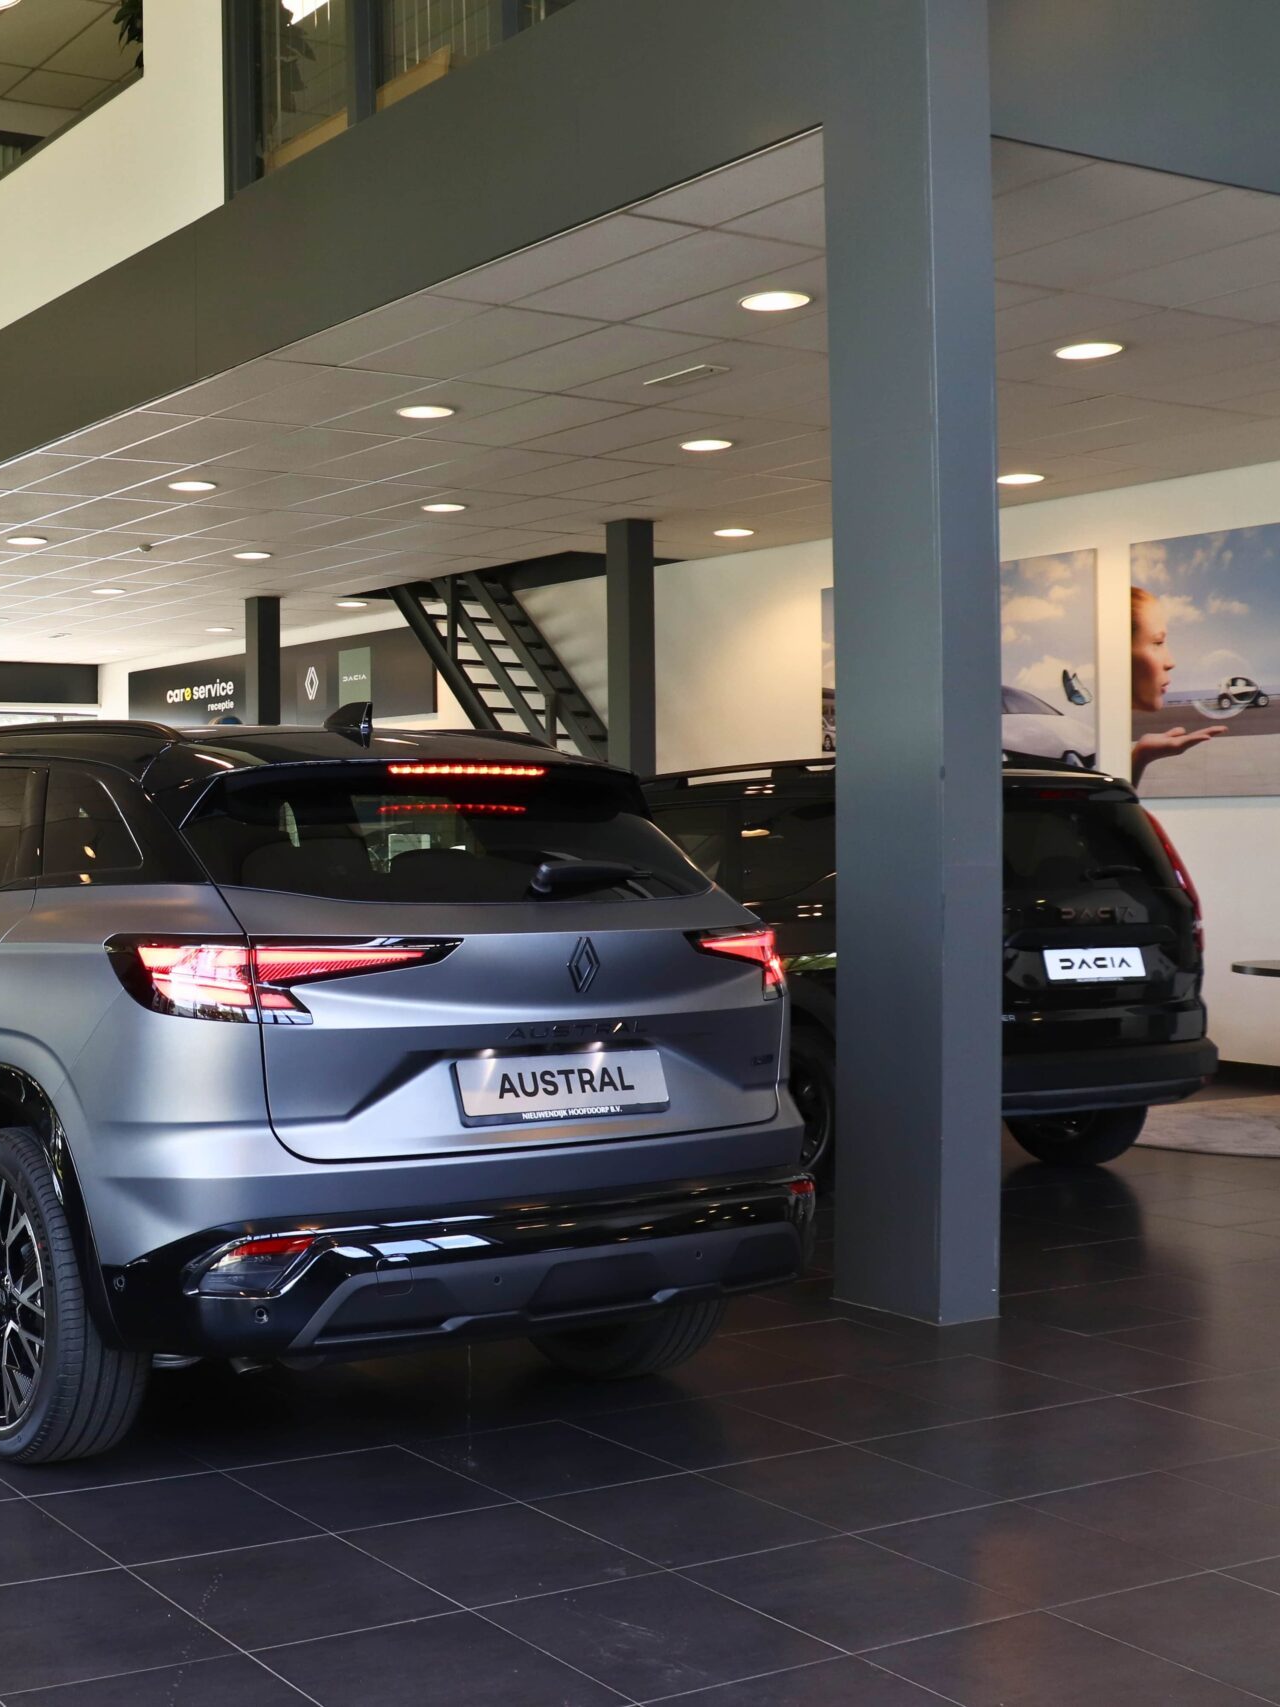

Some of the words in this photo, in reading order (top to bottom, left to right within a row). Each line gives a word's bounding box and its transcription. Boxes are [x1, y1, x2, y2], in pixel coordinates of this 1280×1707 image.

[342, 674, 367, 682] DACIA
[166, 687, 192, 703] care
[193, 679, 234, 699] service
[207, 700, 234, 712] receptie
[1059, 956, 1131, 970] DACIA
[505, 1020, 648, 1040] AUSTRAL
[499, 1066, 635, 1099] AUSTRAL
[522, 1108, 568, 1119] NIEUWENDIJK
[568, 1106, 609, 1116] HOOFDDORP
